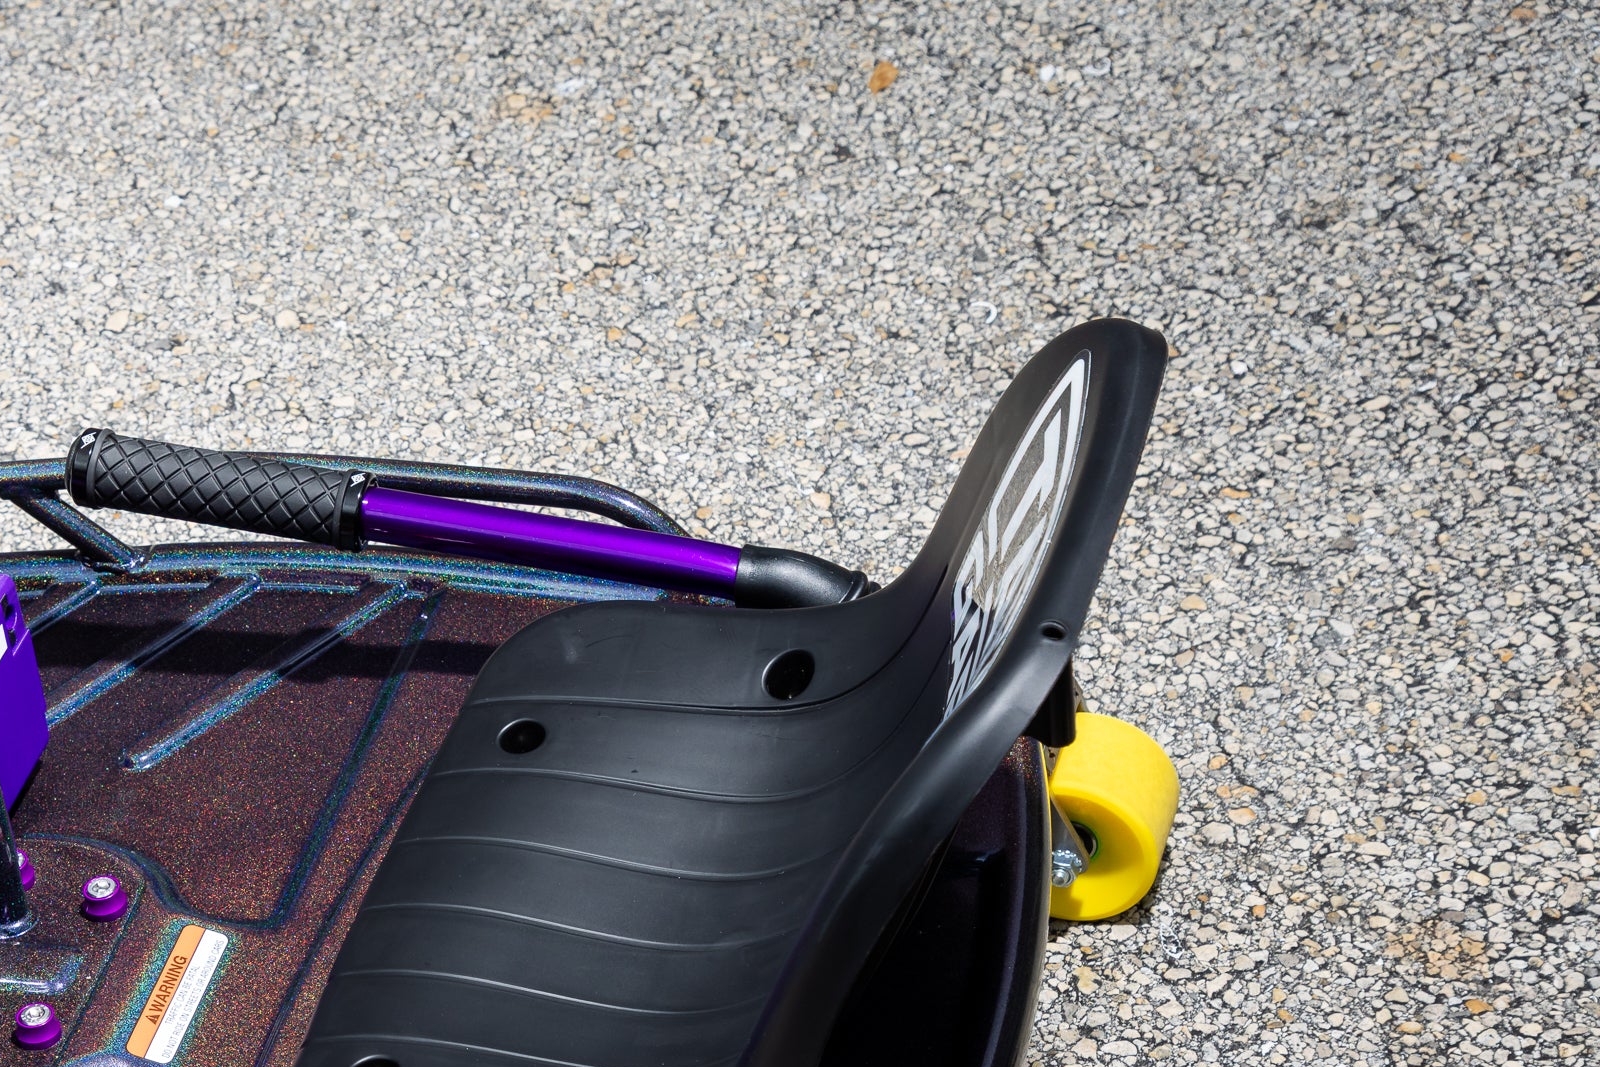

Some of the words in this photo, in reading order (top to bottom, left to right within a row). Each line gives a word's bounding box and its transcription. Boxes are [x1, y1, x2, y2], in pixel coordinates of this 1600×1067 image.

[211, 939, 225, 956] CARS
[186, 965, 200, 981] FATAL
[200, 955, 217, 979] AROUND
[149, 955, 188, 1013] WARNING
[182, 981, 192, 990] BE
[195, 978, 207, 988] OR
[176, 990, 188, 1003] CAN
[184, 987, 202, 1013] STREETS
[165, 1001, 182, 1025] TRAFFIC
[179, 1013, 190, 1022] ON
[172, 1022, 186, 1036] RIDE
[166, 1036, 178, 1049] NOT
[161, 1049, 173, 1058] DO
